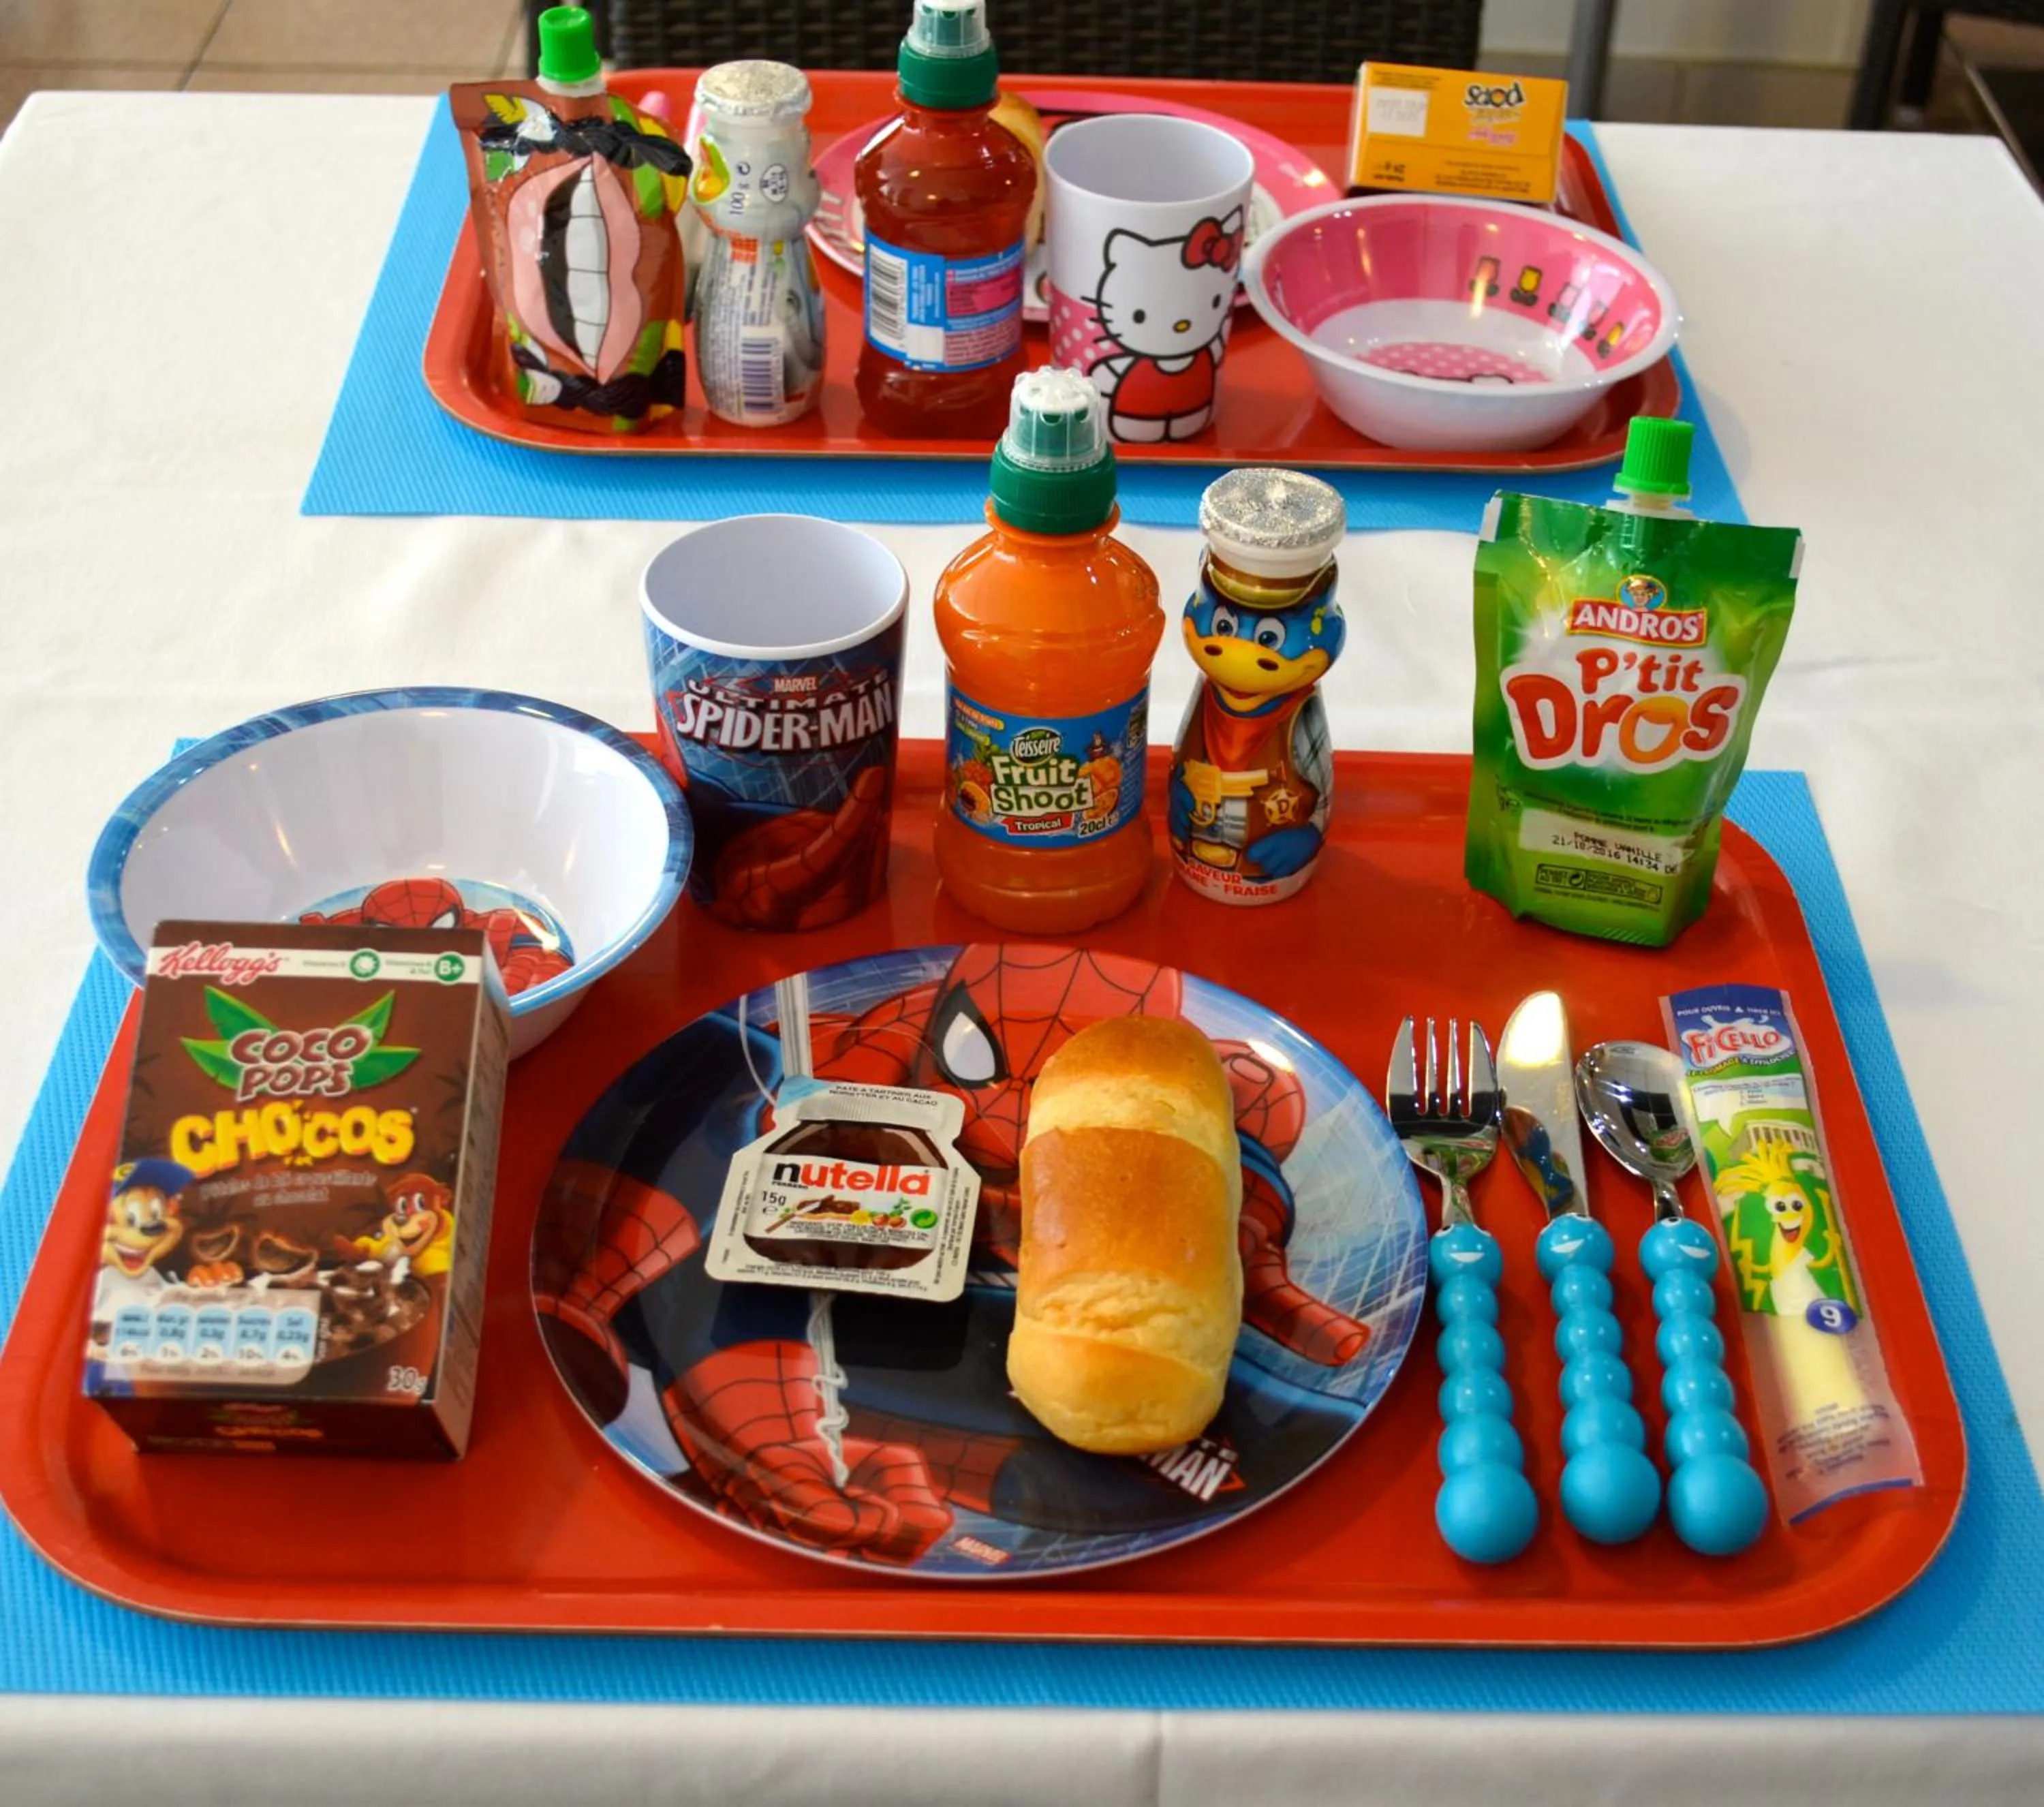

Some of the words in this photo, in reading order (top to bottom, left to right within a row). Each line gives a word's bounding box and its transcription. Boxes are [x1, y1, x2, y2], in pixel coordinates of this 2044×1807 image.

[1575, 604, 1699, 641] ANDROS
[774, 676, 817, 693] MARVEL
[1576, 647, 1703, 694] P'tit
[677, 682, 893, 750] SPIDER-MAN
[1506, 674, 1739, 764] Dros
[1012, 732, 1061, 758] Teisseire
[991, 755, 1077, 786] Fruit
[993, 782, 1088, 812] Shoot
[1015, 818, 1062, 831] Tropical
[1080, 816, 1106, 836] 20cl
[1224, 884, 1278, 896] FRAISE
[157, 942, 281, 984] Kellogg's
[231, 1025, 373, 1065] COCO
[236, 1060, 353, 1102] POPS
[171, 1101, 415, 1178] CHOCOS
[773, 1160, 931, 1196] nutella
[762, 1190, 787, 1207] 15g
[1819, 1305, 1842, 1328] 9
[386, 1365, 428, 1396] 30g
